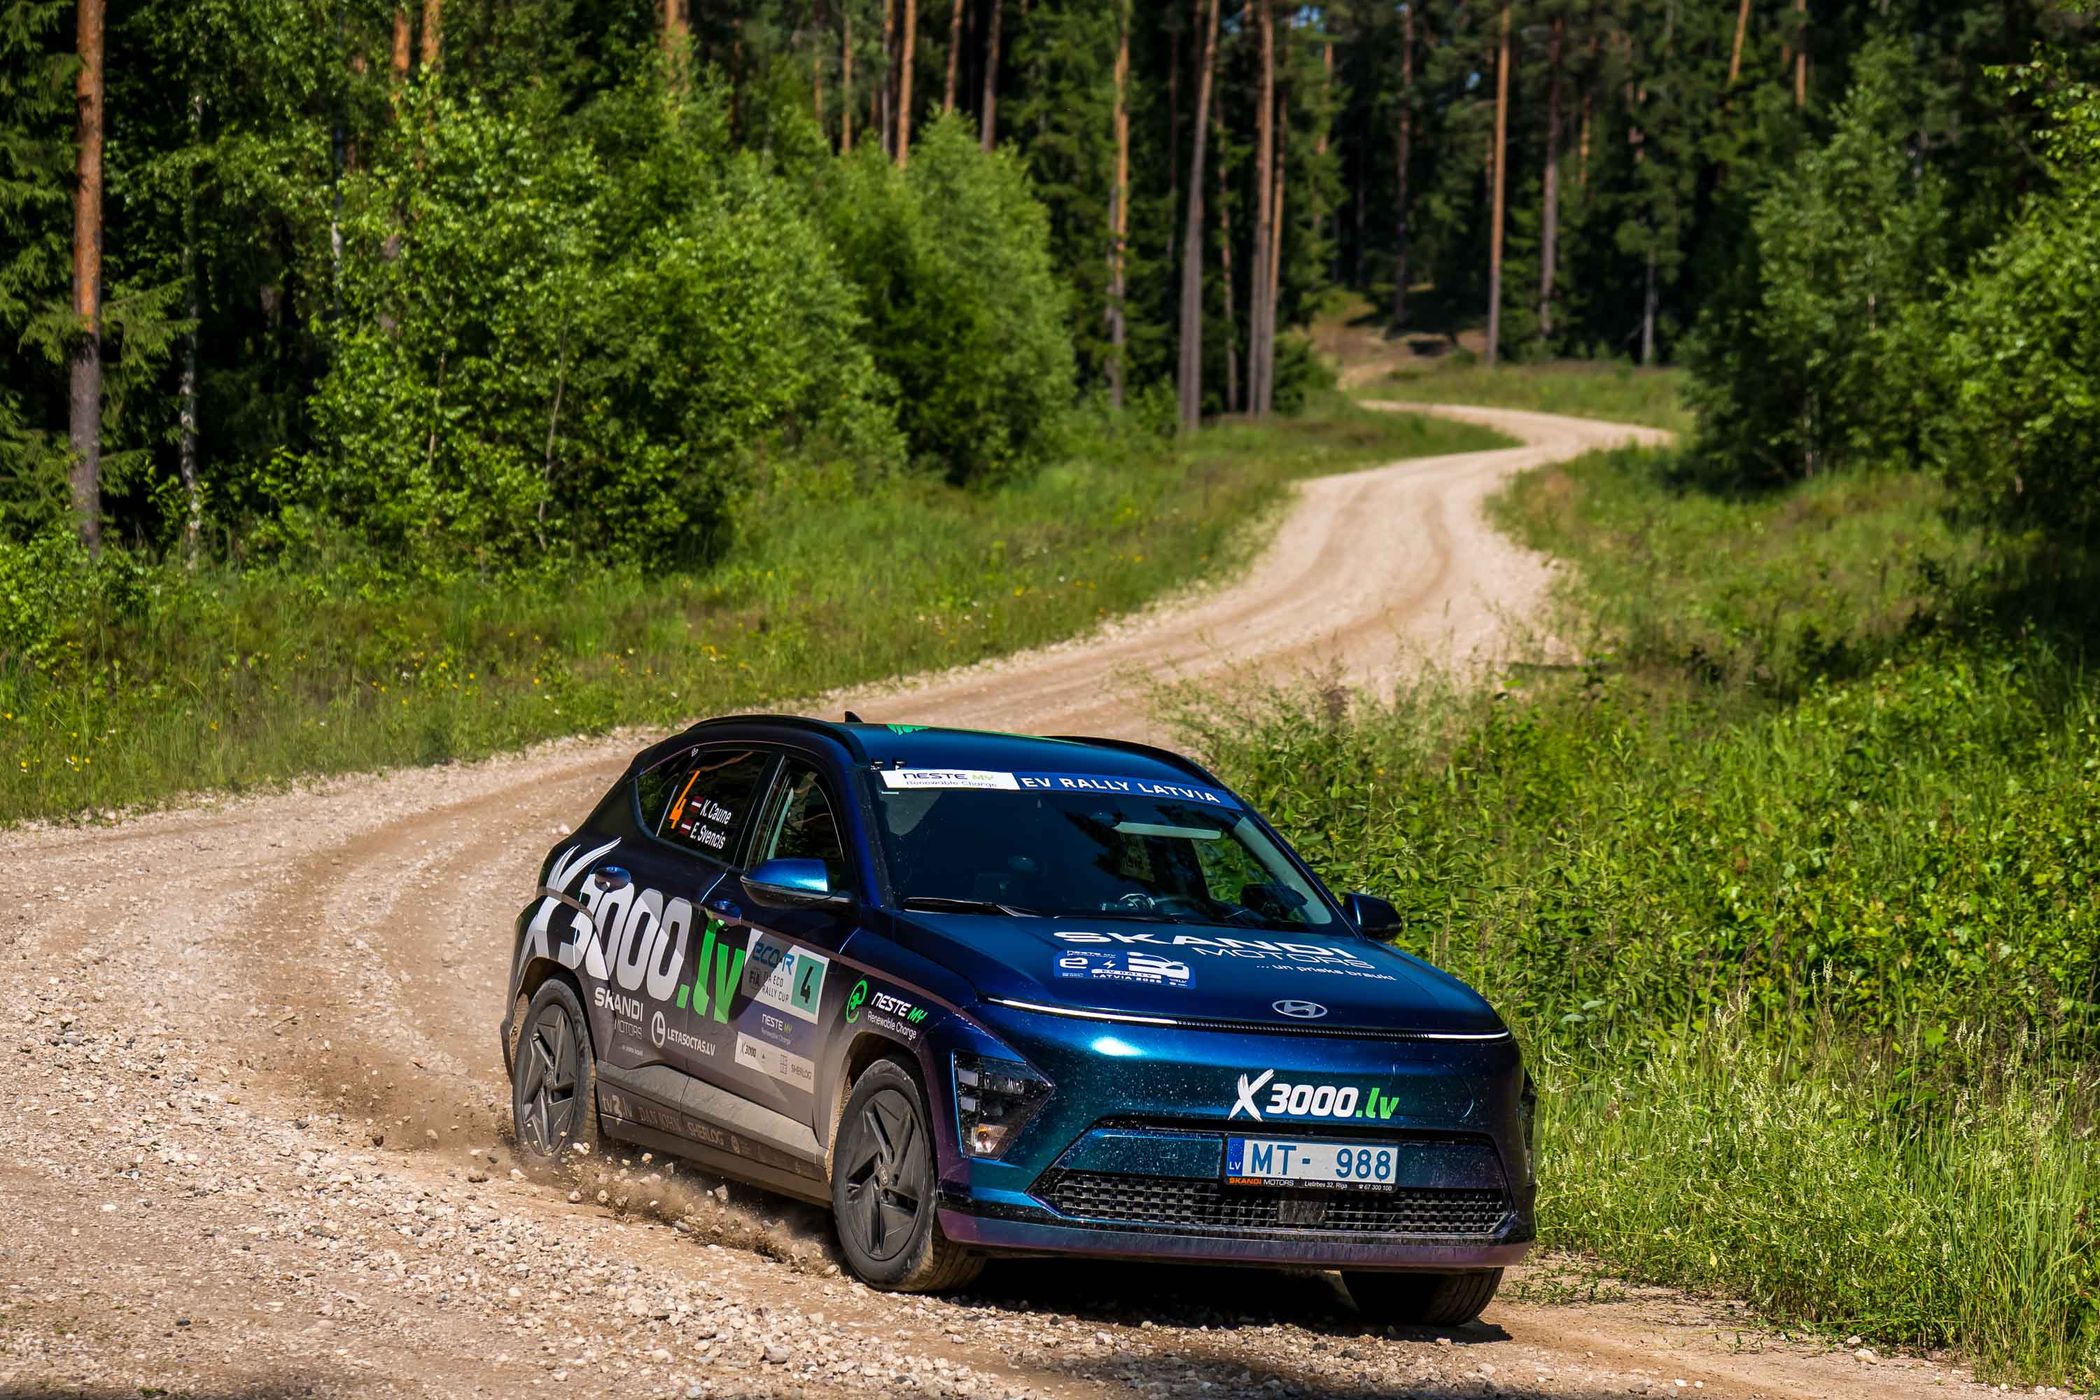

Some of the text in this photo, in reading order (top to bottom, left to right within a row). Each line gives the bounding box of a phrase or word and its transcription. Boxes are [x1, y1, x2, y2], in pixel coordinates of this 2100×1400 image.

[669, 769, 700, 829] 4
[1024, 777, 1051, 788] EV
[1059, 778, 1130, 792] RALLY
[1140, 783, 1221, 803] LATVIA
[708, 802, 732, 825] Caune
[698, 824, 726, 849] Svencis
[1053, 931, 1358, 959] SKANDI
[1192, 947, 1376, 970] MOTORS
[772, 975, 784, 988] ECO
[800, 965, 814, 1004] 4
[594, 986, 643, 1022] SKANDI
[778, 991, 789, 1002] CUP
[871, 992, 928, 1023] NESTE MY
[761, 1013, 783, 1031] NESTE
[867, 1010, 917, 1040] Renewable Charge
[667, 1027, 716, 1057] LETASOCTAS.LV
[1229, 1161, 1242, 1171] LV
[1335, 1148, 1391, 1180] 988
[1229, 1177, 1262, 1185] SKANDI
[1263, 1179, 1294, 1187] MOTORS
